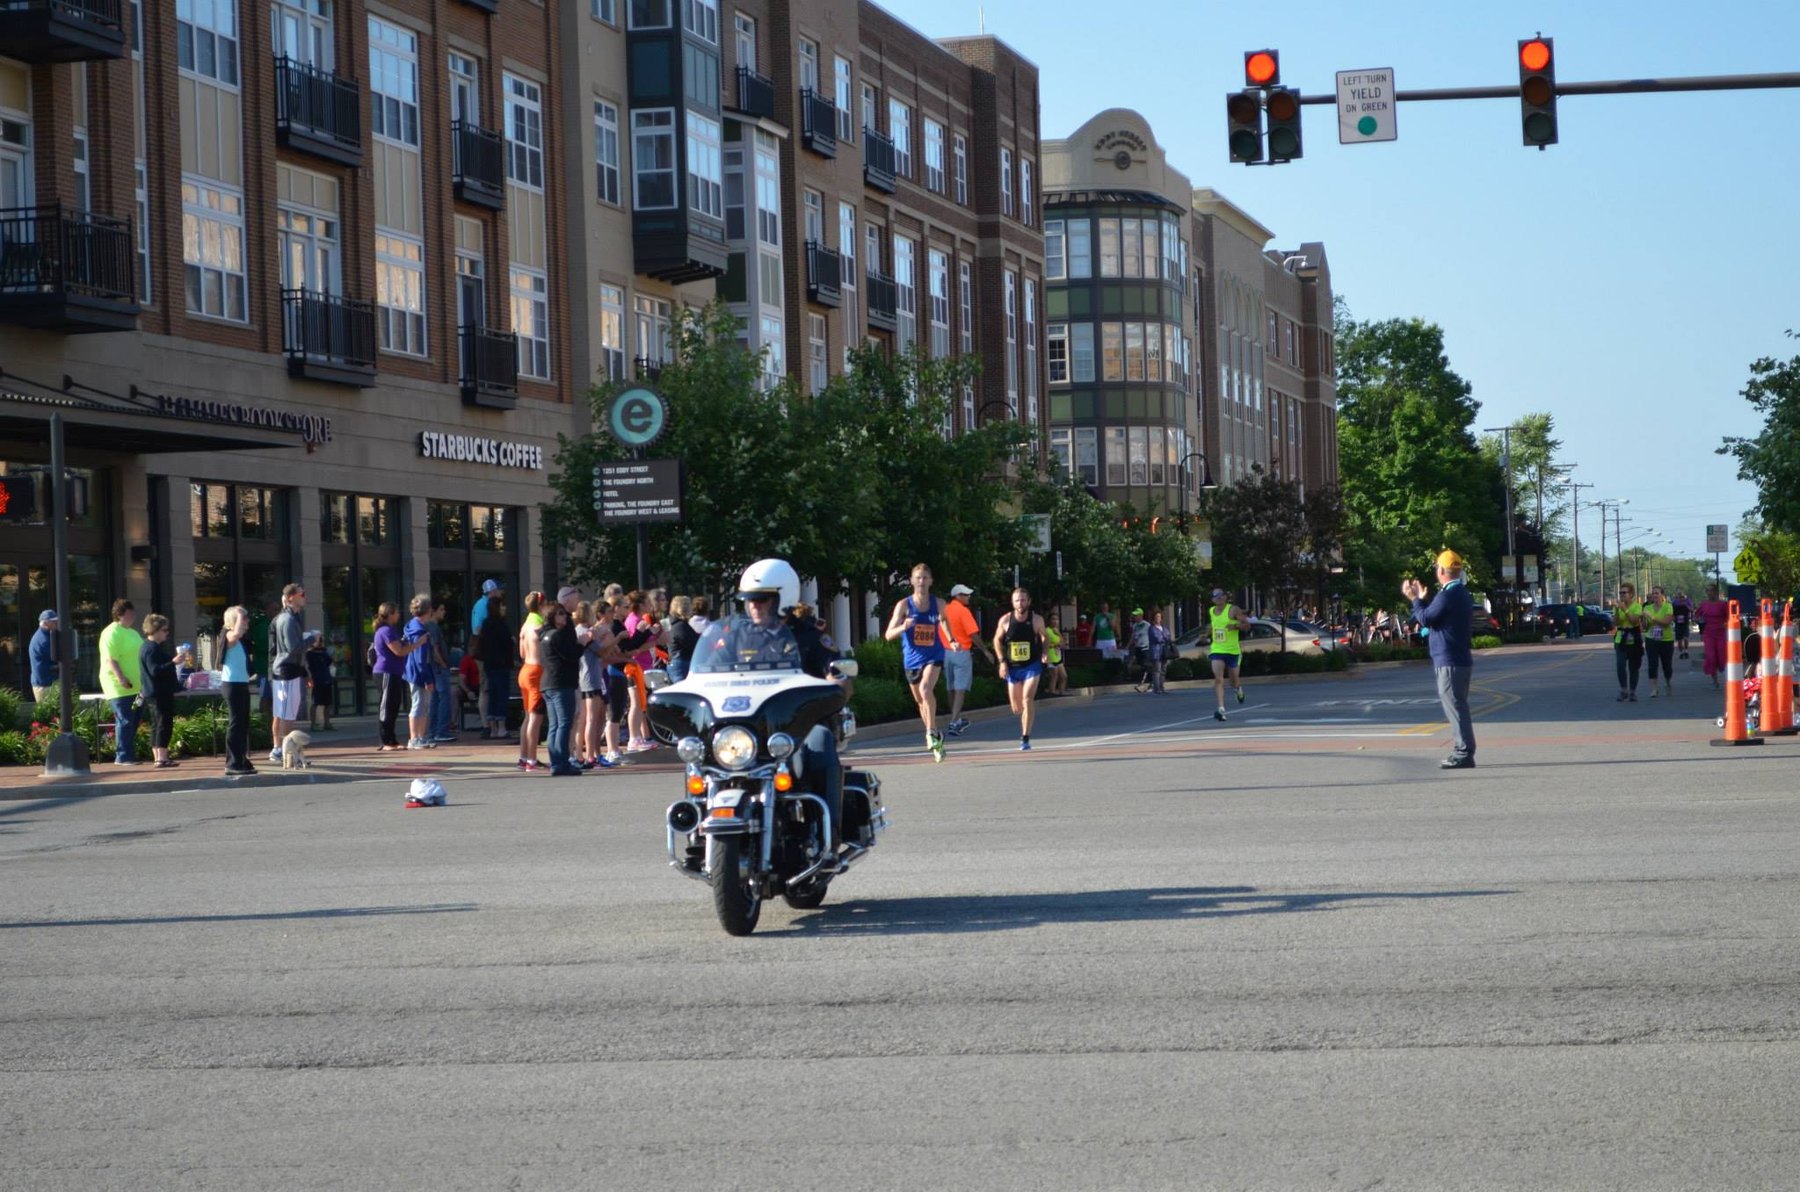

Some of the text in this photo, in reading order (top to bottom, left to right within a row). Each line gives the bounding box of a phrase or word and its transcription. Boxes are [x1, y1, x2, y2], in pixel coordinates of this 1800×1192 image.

[1343, 74, 1386, 85] LEFT TURN
[1350, 87, 1382, 100] YIELD
[1345, 101, 1388, 113] ON GREEN
[621, 398, 653, 432] e
[421, 431, 543, 470] STARBUCKS COFFEE
[613, 478, 636, 486] FOUNDRY
[637, 499, 660, 507] FOUNDRY
[614, 508, 637, 516] FOUNDRY
[638, 507, 652, 516] WEST
[658, 506, 680, 514] LEASING
[753, 678, 780, 686] POLICE
